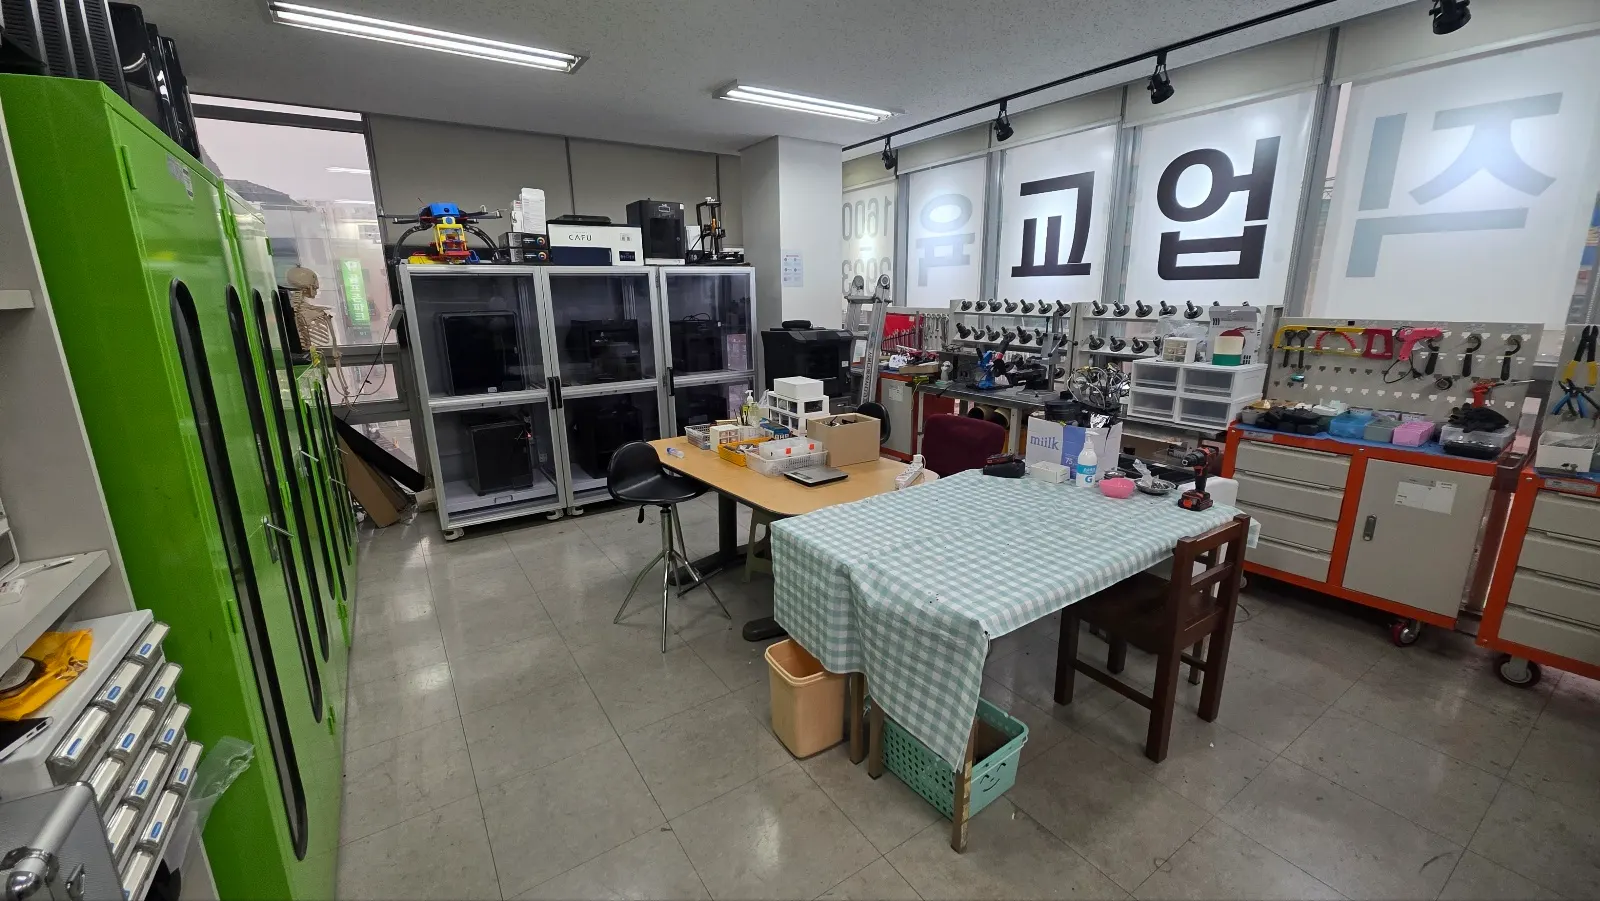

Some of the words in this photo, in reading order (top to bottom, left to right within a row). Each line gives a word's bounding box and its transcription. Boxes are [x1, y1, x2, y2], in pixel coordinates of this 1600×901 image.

[1010, 170, 1096, 278] 교
[1156, 135, 1281, 281] 업
[1030, 435, 1060, 451] miilk
[1085, 475, 1093, 483] G
